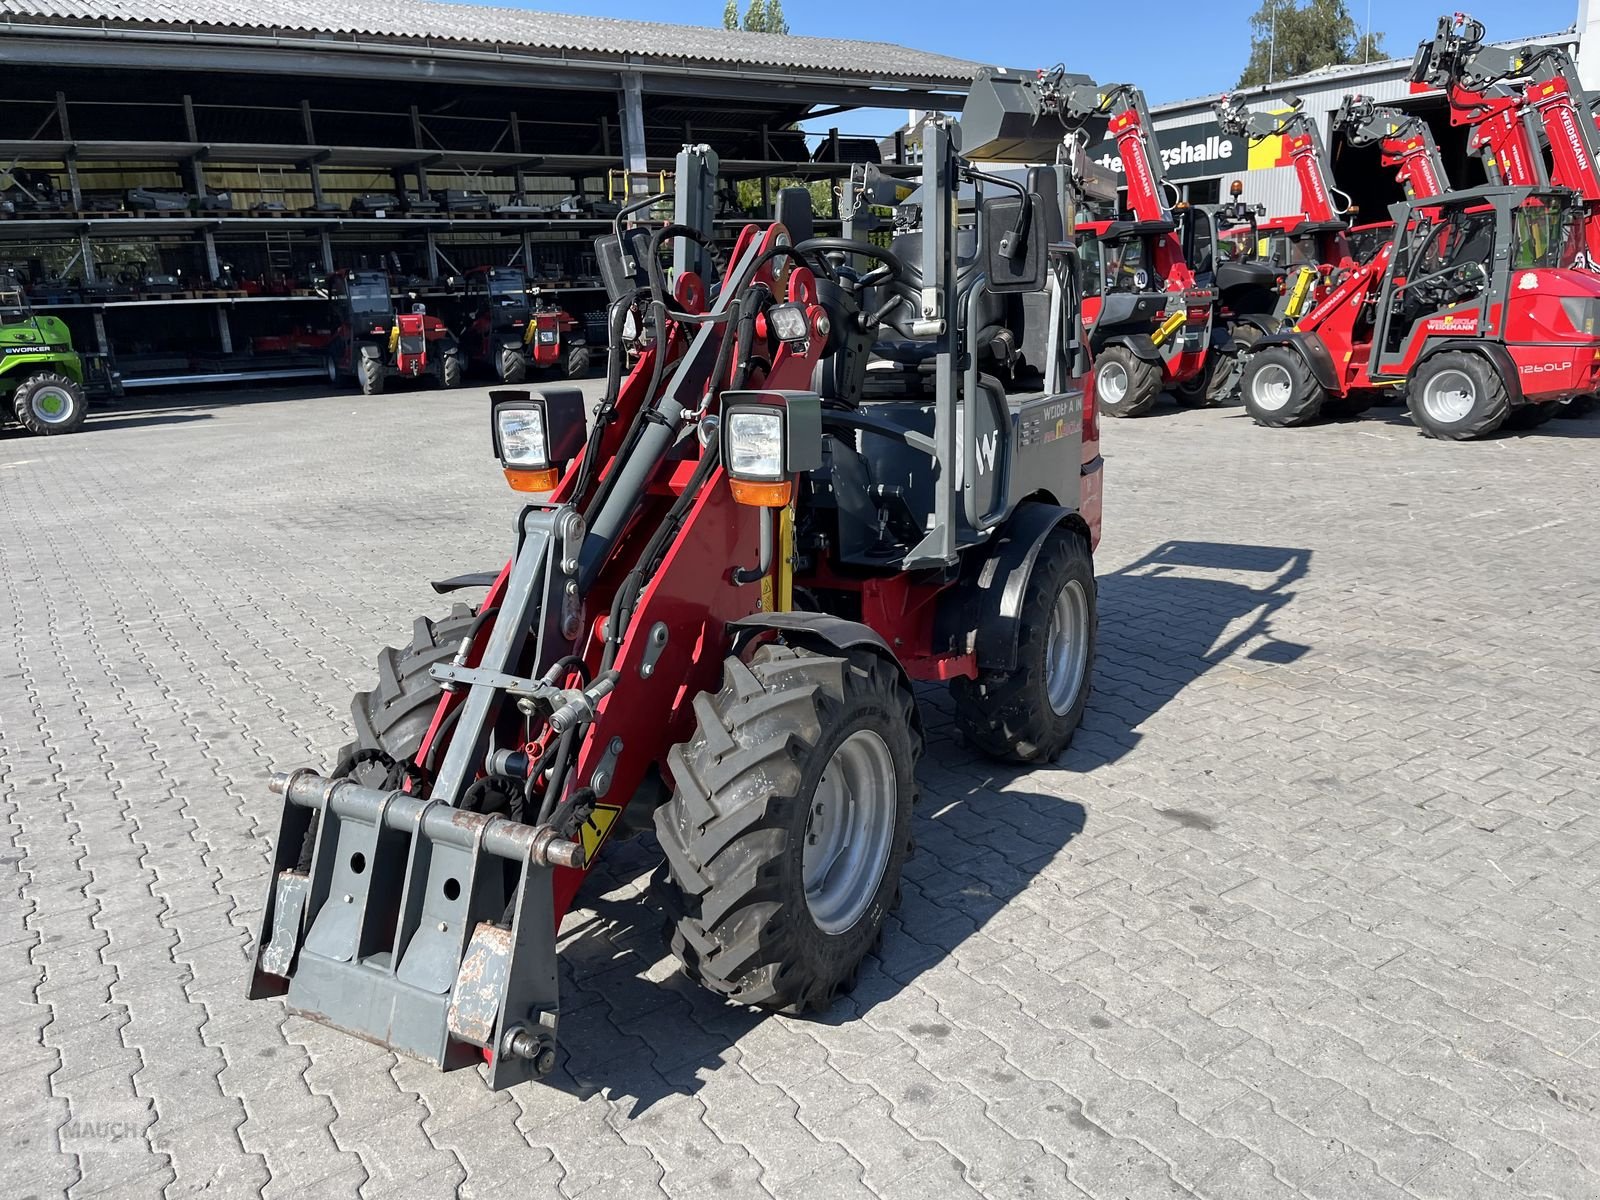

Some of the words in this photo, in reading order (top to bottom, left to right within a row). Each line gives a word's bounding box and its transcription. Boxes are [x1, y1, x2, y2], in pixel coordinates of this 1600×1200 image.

[1560, 108, 1588, 170] WEIDEMANN
[1131, 142, 1151, 197] WEIDEMANN
[1306, 158, 1325, 203] WEIDEMANN
[1137, 272, 1146, 285] 20
[1520, 361, 1572, 374] 1260LP
